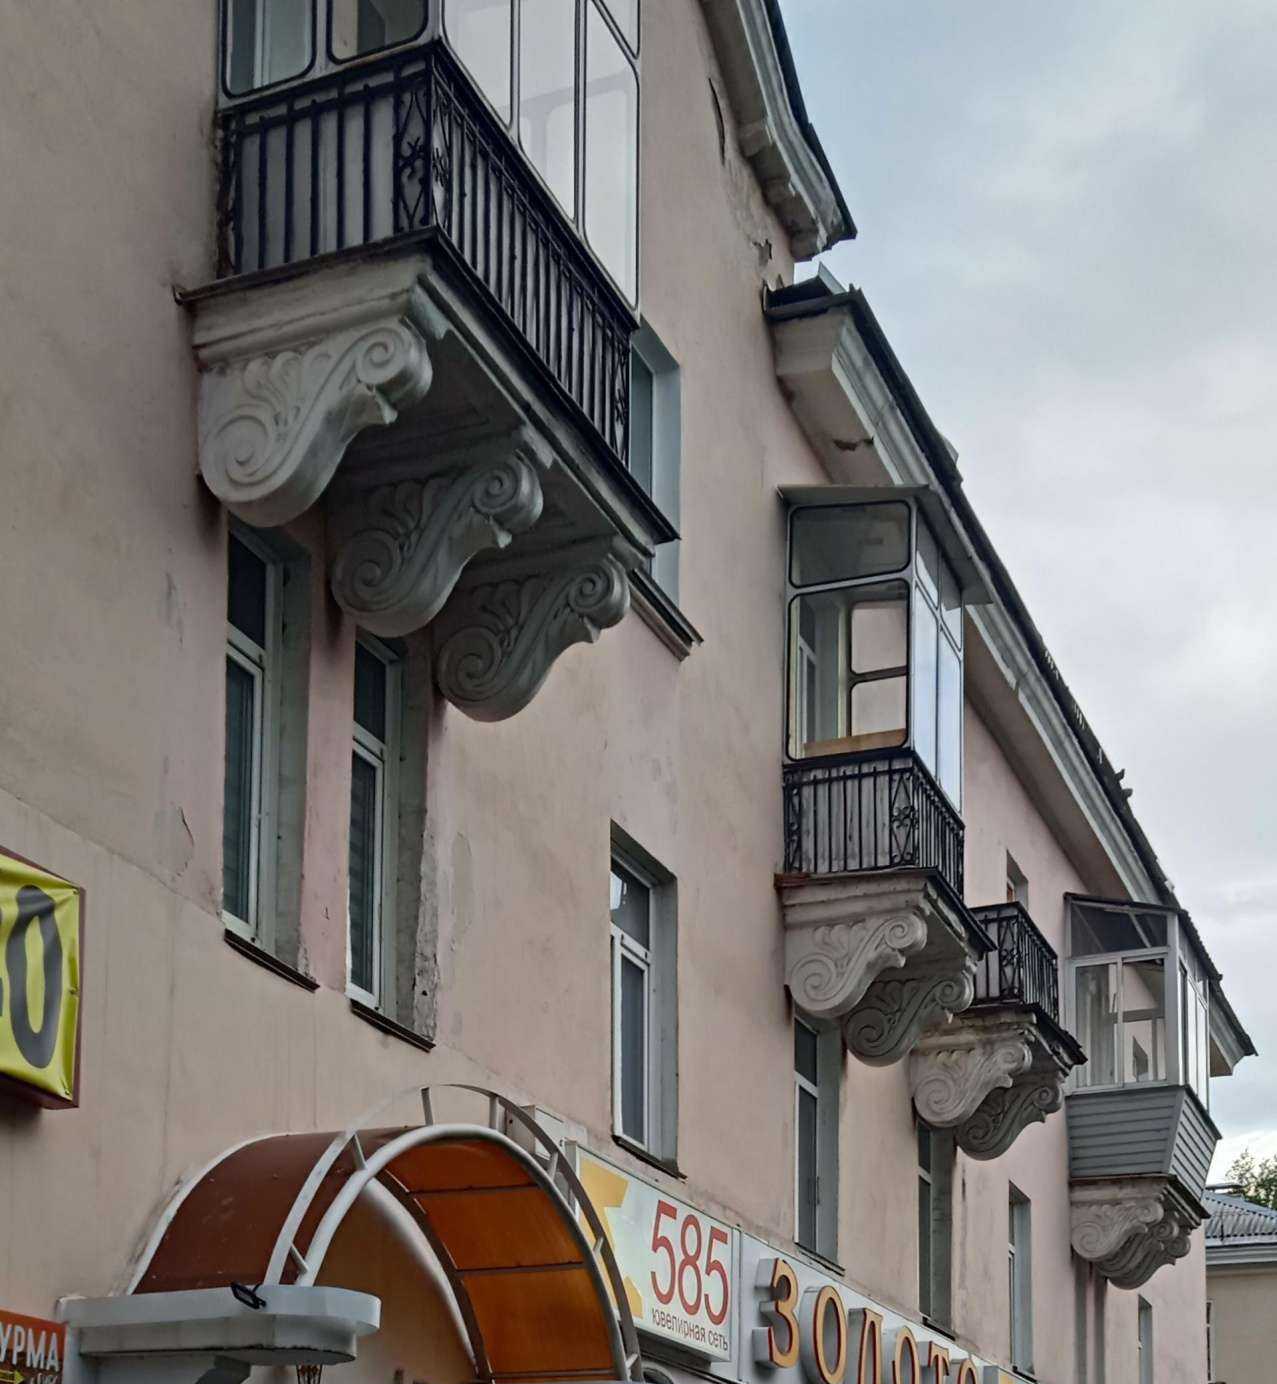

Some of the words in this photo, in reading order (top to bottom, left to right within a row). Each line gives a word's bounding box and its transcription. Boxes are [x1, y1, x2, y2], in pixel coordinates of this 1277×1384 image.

[651, 1200, 729, 1326] 585
[652, 1308, 706, 1343] ювелирная
[708, 1330, 729, 1351] сеть
